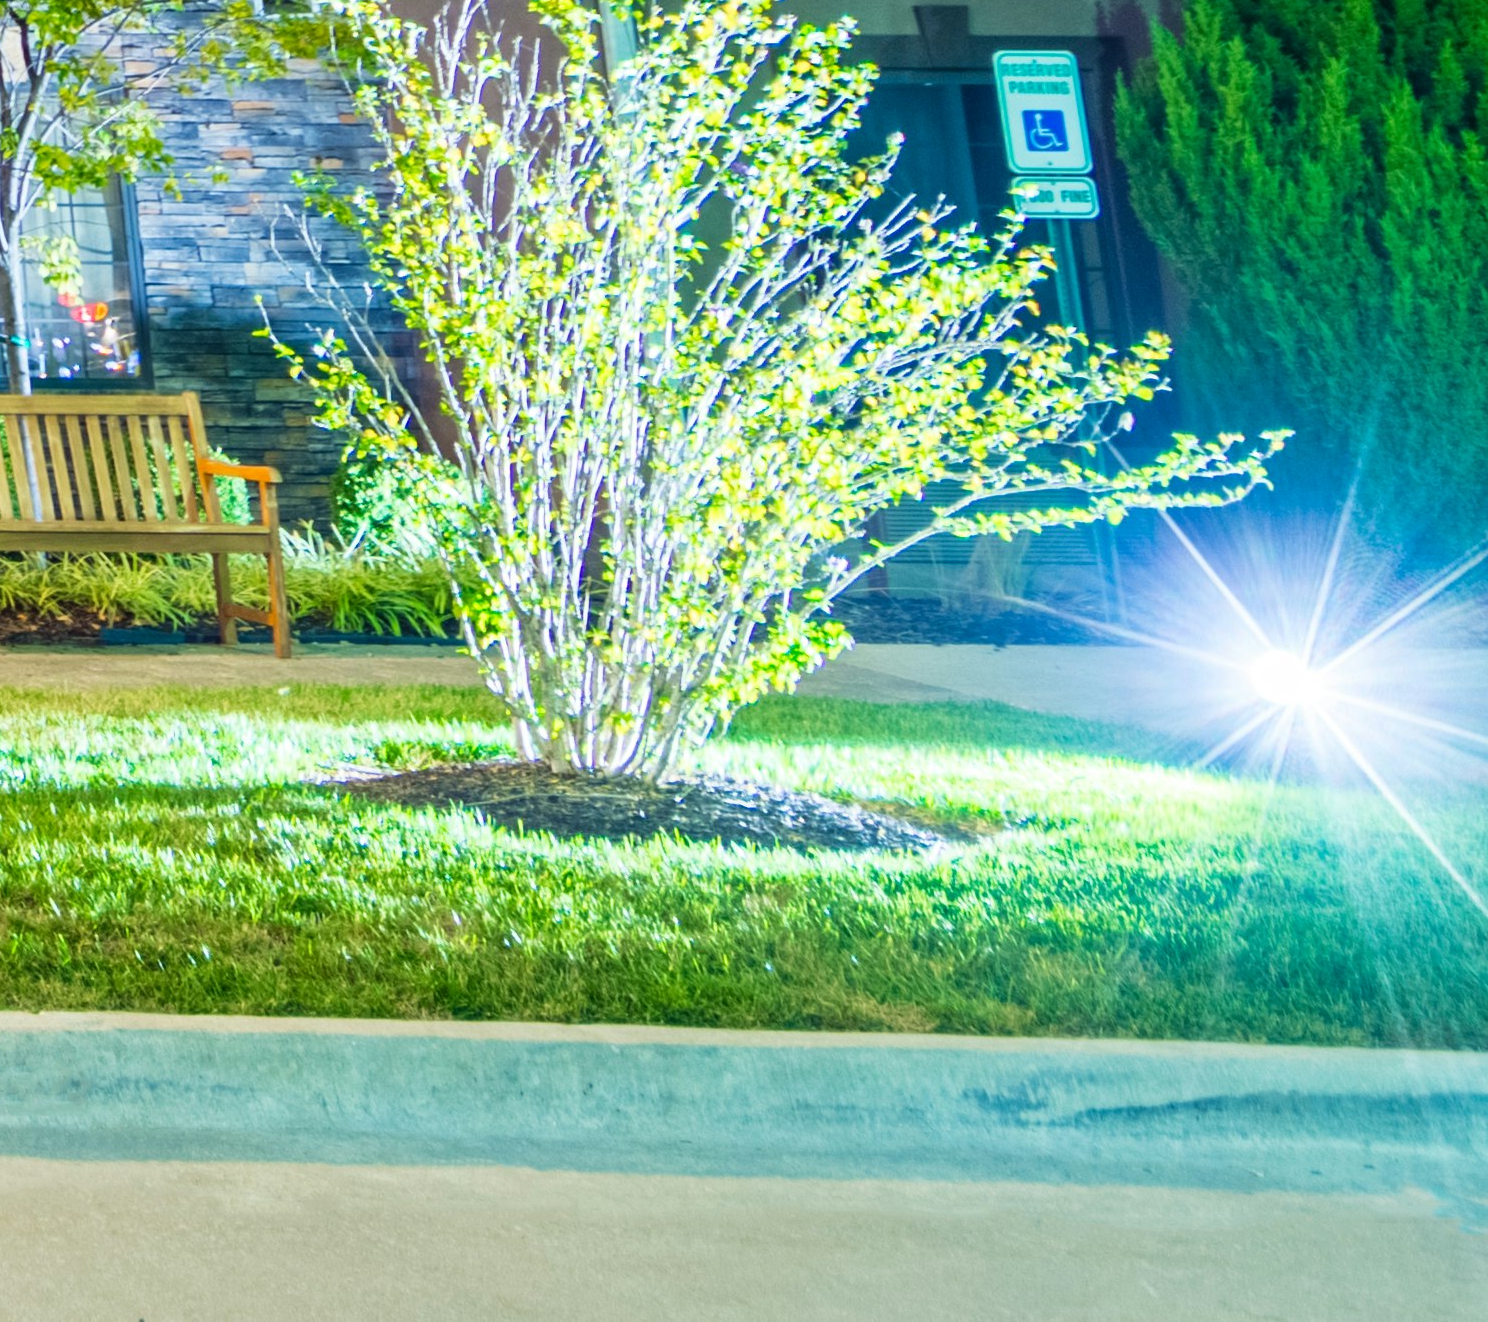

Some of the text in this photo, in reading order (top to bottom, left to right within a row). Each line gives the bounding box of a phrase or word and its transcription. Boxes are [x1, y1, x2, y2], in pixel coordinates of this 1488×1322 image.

[1001, 64, 1072, 77] RESERVED
[1008, 81, 1070, 95] PARKING
[1060, 190, 1091, 203] FINE
